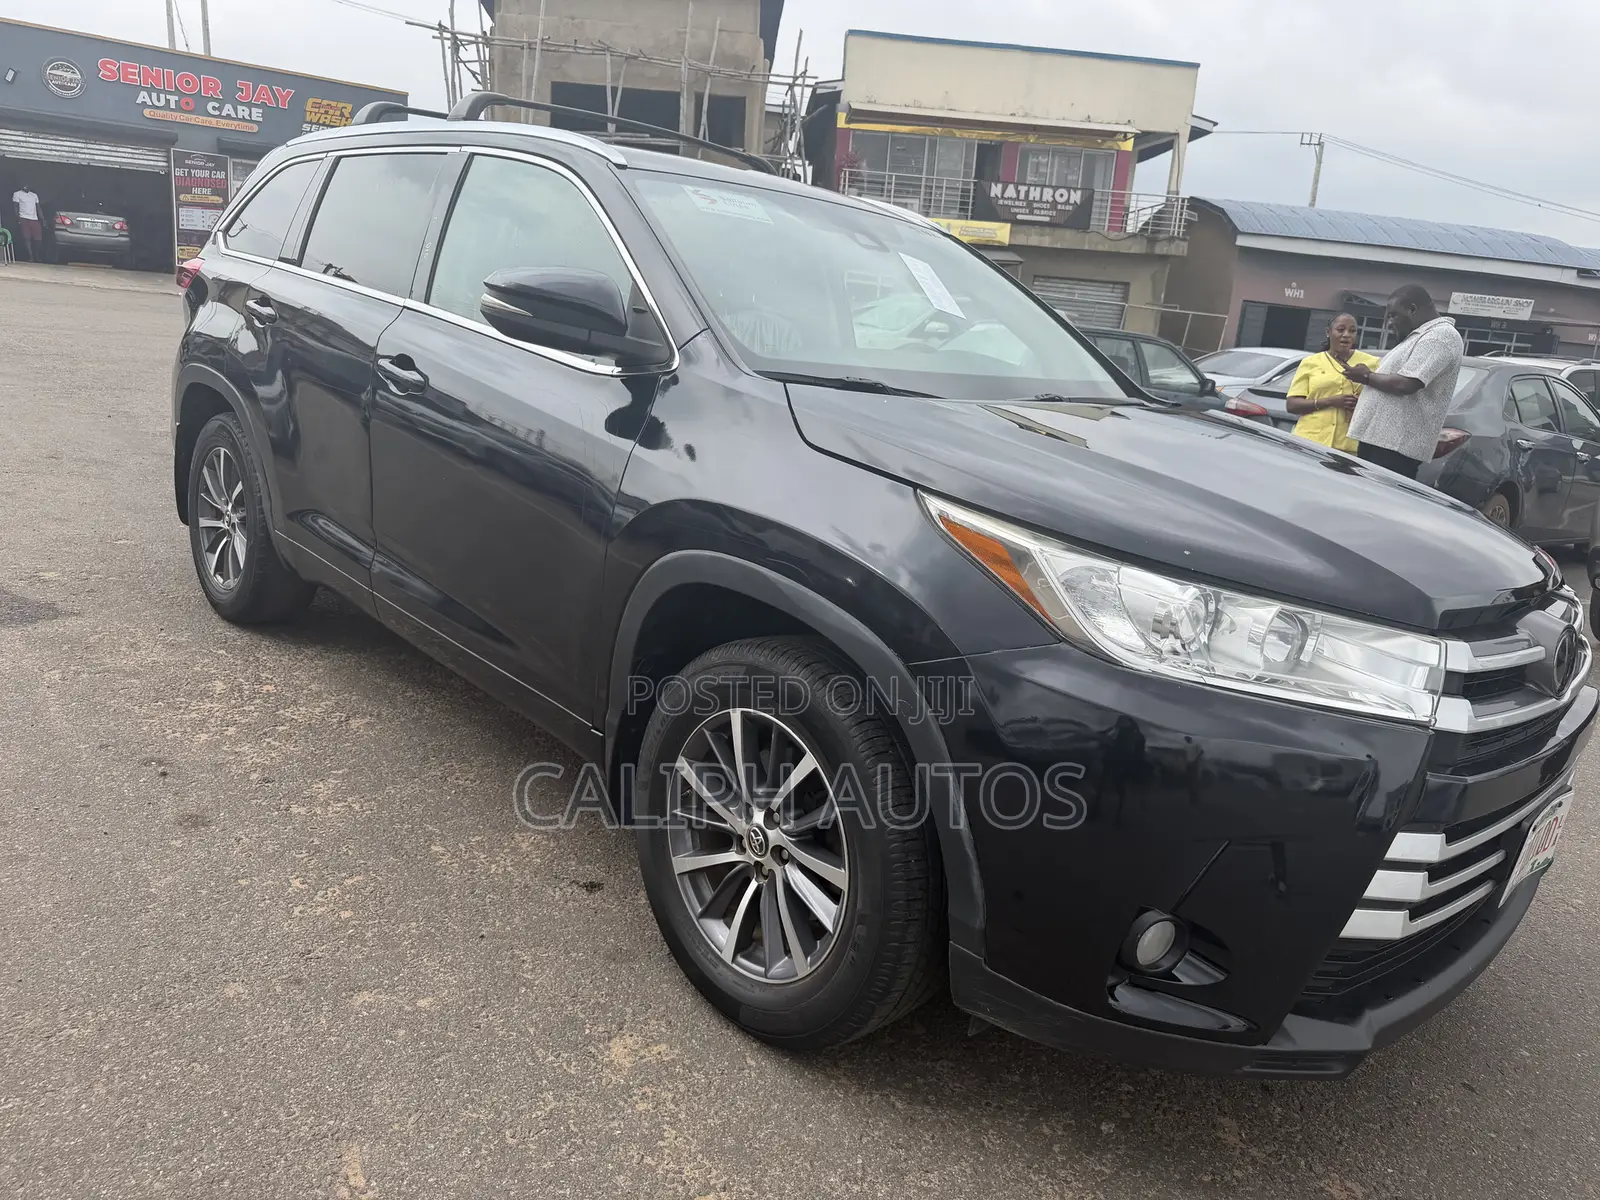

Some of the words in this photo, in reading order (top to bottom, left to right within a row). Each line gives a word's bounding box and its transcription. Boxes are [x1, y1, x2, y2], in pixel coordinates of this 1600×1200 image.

[98, 58, 223, 99] SENIOR
[236, 79, 296, 109] JAY
[136, 90, 195, 112] AUTO
[206, 101, 264, 122] CARE
[148, 110, 178, 120] Quality
[178, 113, 192, 123] Car
[215, 119, 255, 131] Everytime
[175, 167, 189, 177] GET
[190, 168, 210, 178] YOUR
[211, 170, 226, 179] CAR
[175, 176, 227, 189] DIAGNOSED
[192, 187, 212, 195] HERE
[990, 182, 1082, 206] NATHRON
[1284, 287, 1304, 299] WH1
